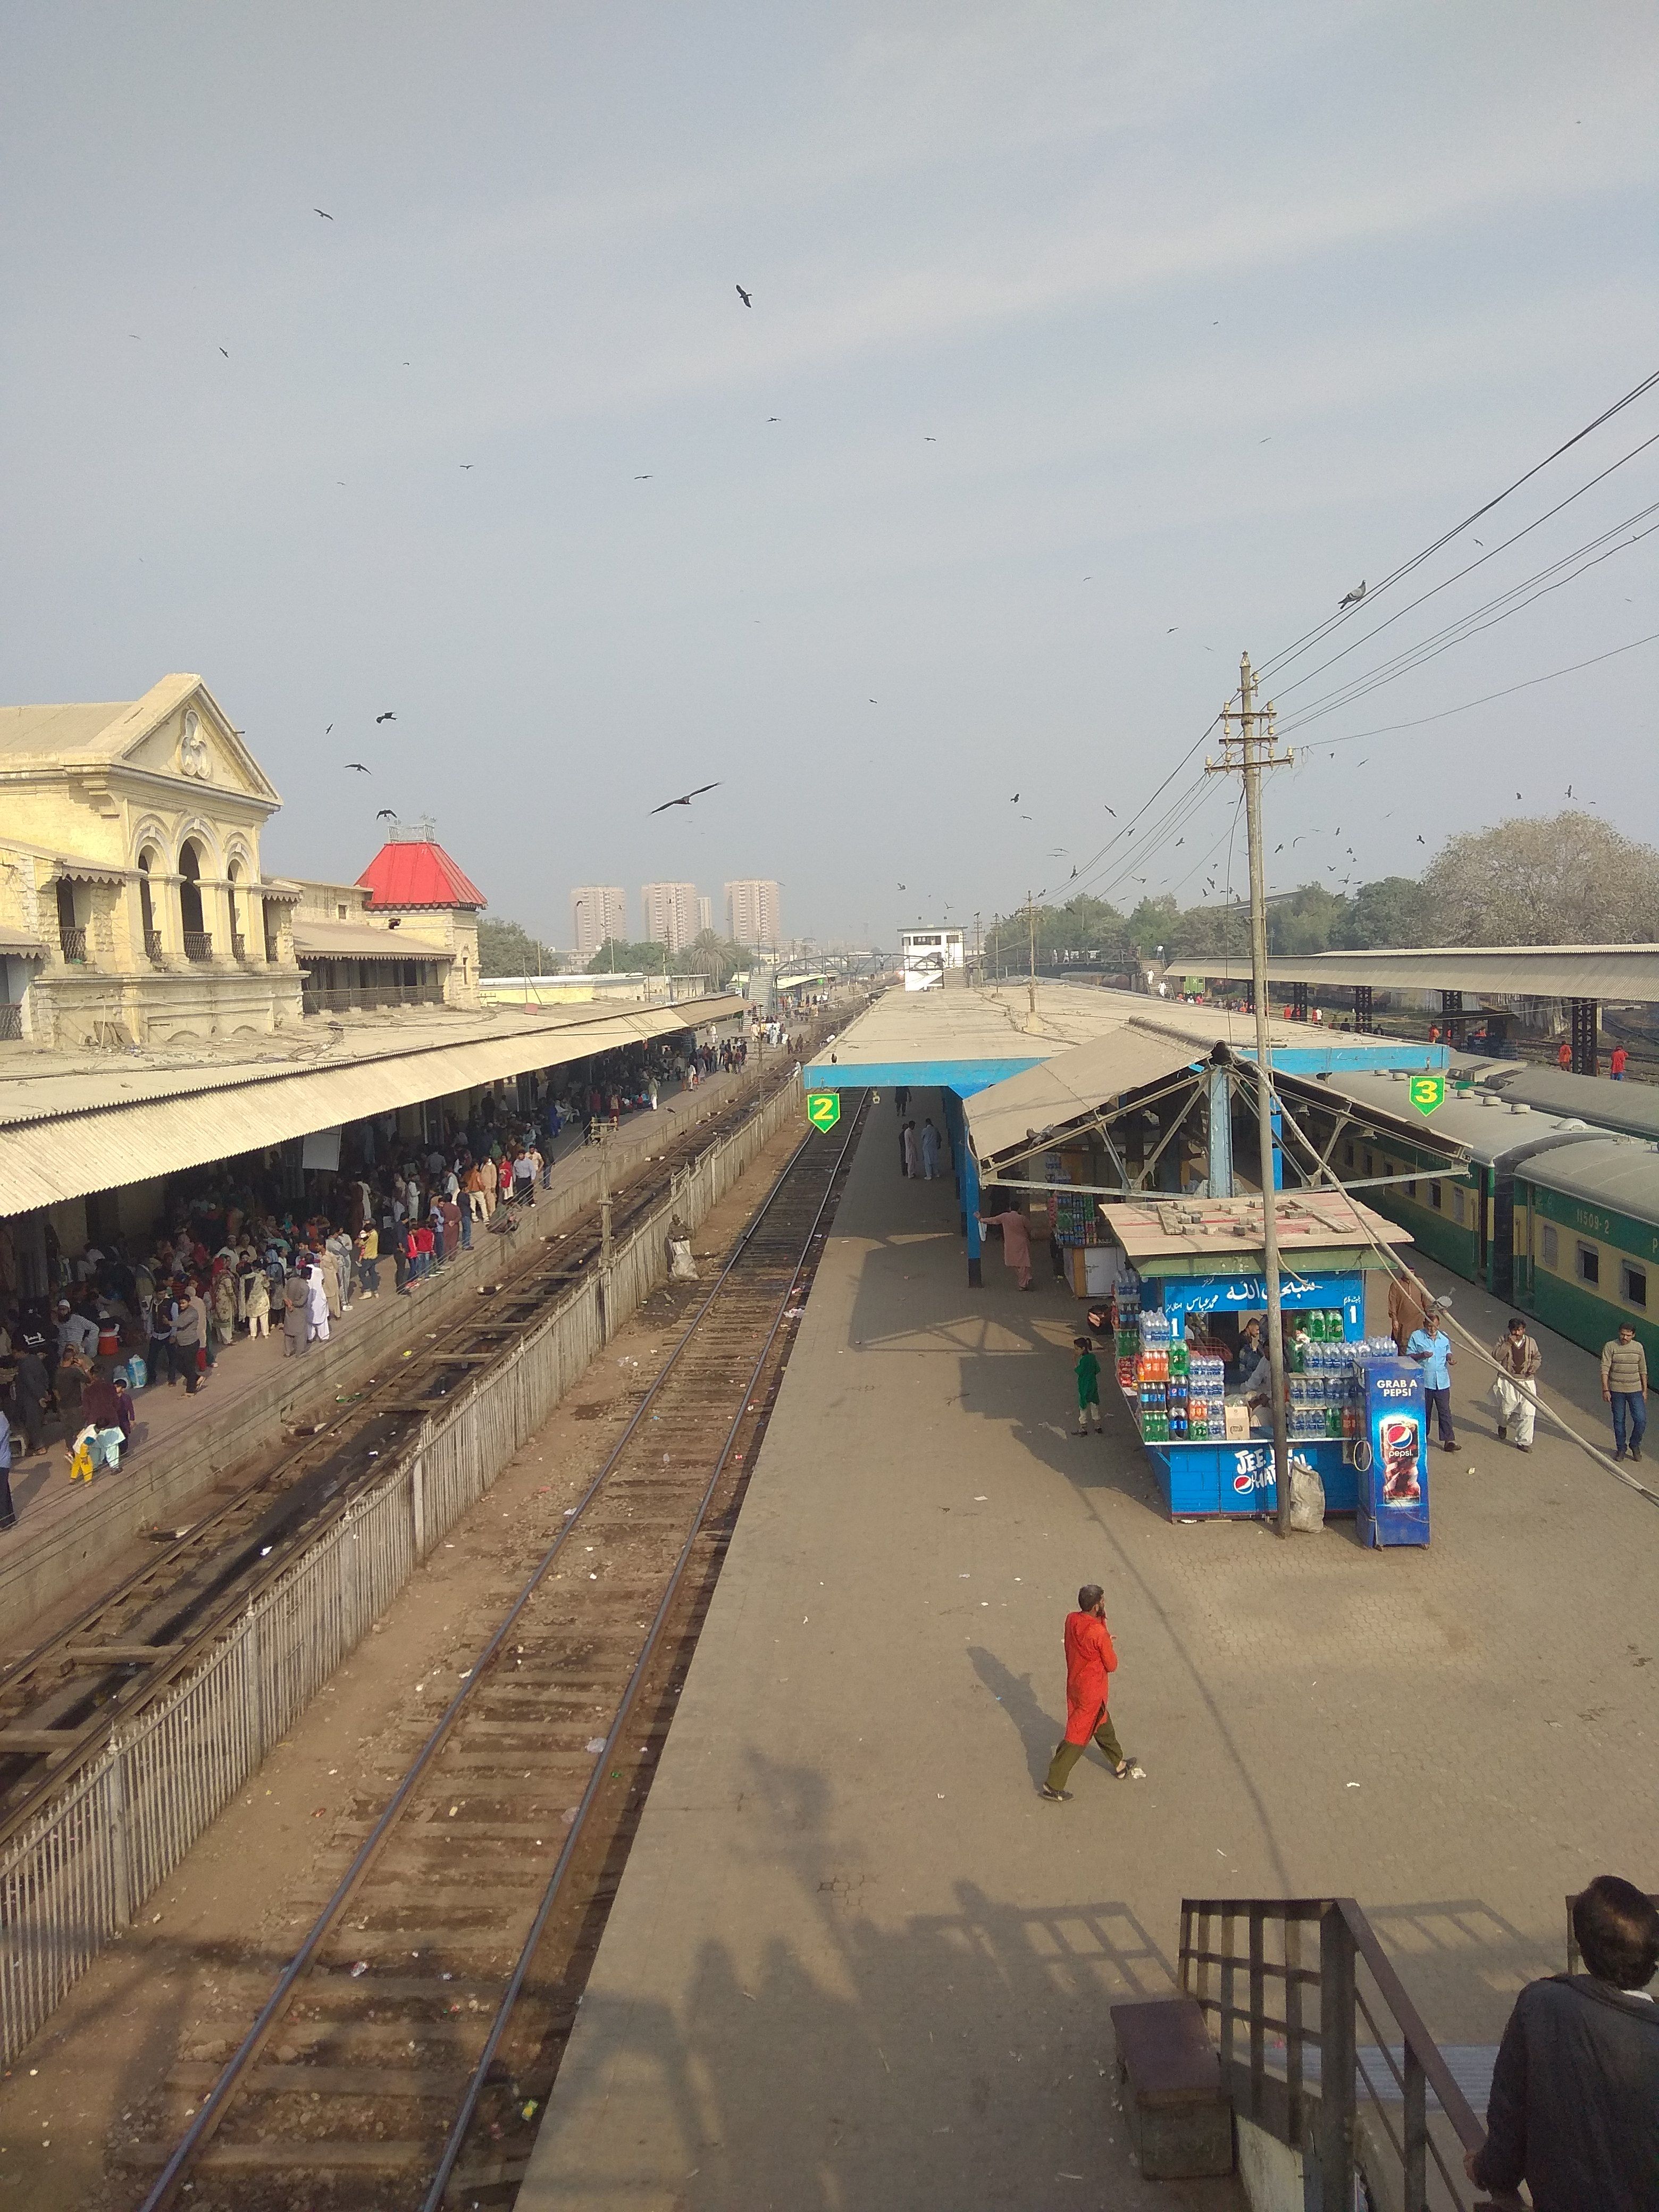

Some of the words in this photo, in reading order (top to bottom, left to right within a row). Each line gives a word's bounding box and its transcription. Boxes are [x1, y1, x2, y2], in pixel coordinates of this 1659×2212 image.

[1415, 1080, 1438, 1103] 3
[814, 1098, 833, 1120] 2
[1186, 1296, 1210, 1311] عباس
[1350, 1305, 1356, 1323] 1
[1171, 1318, 1180, 1337] 1
[1377, 1379, 1407, 1388] GRAB
[1384, 1388, 1412, 1397] PEPSI
[1234, 1448, 1267, 1475] JEE
[1388, 1449, 1412, 1458] pepsi
